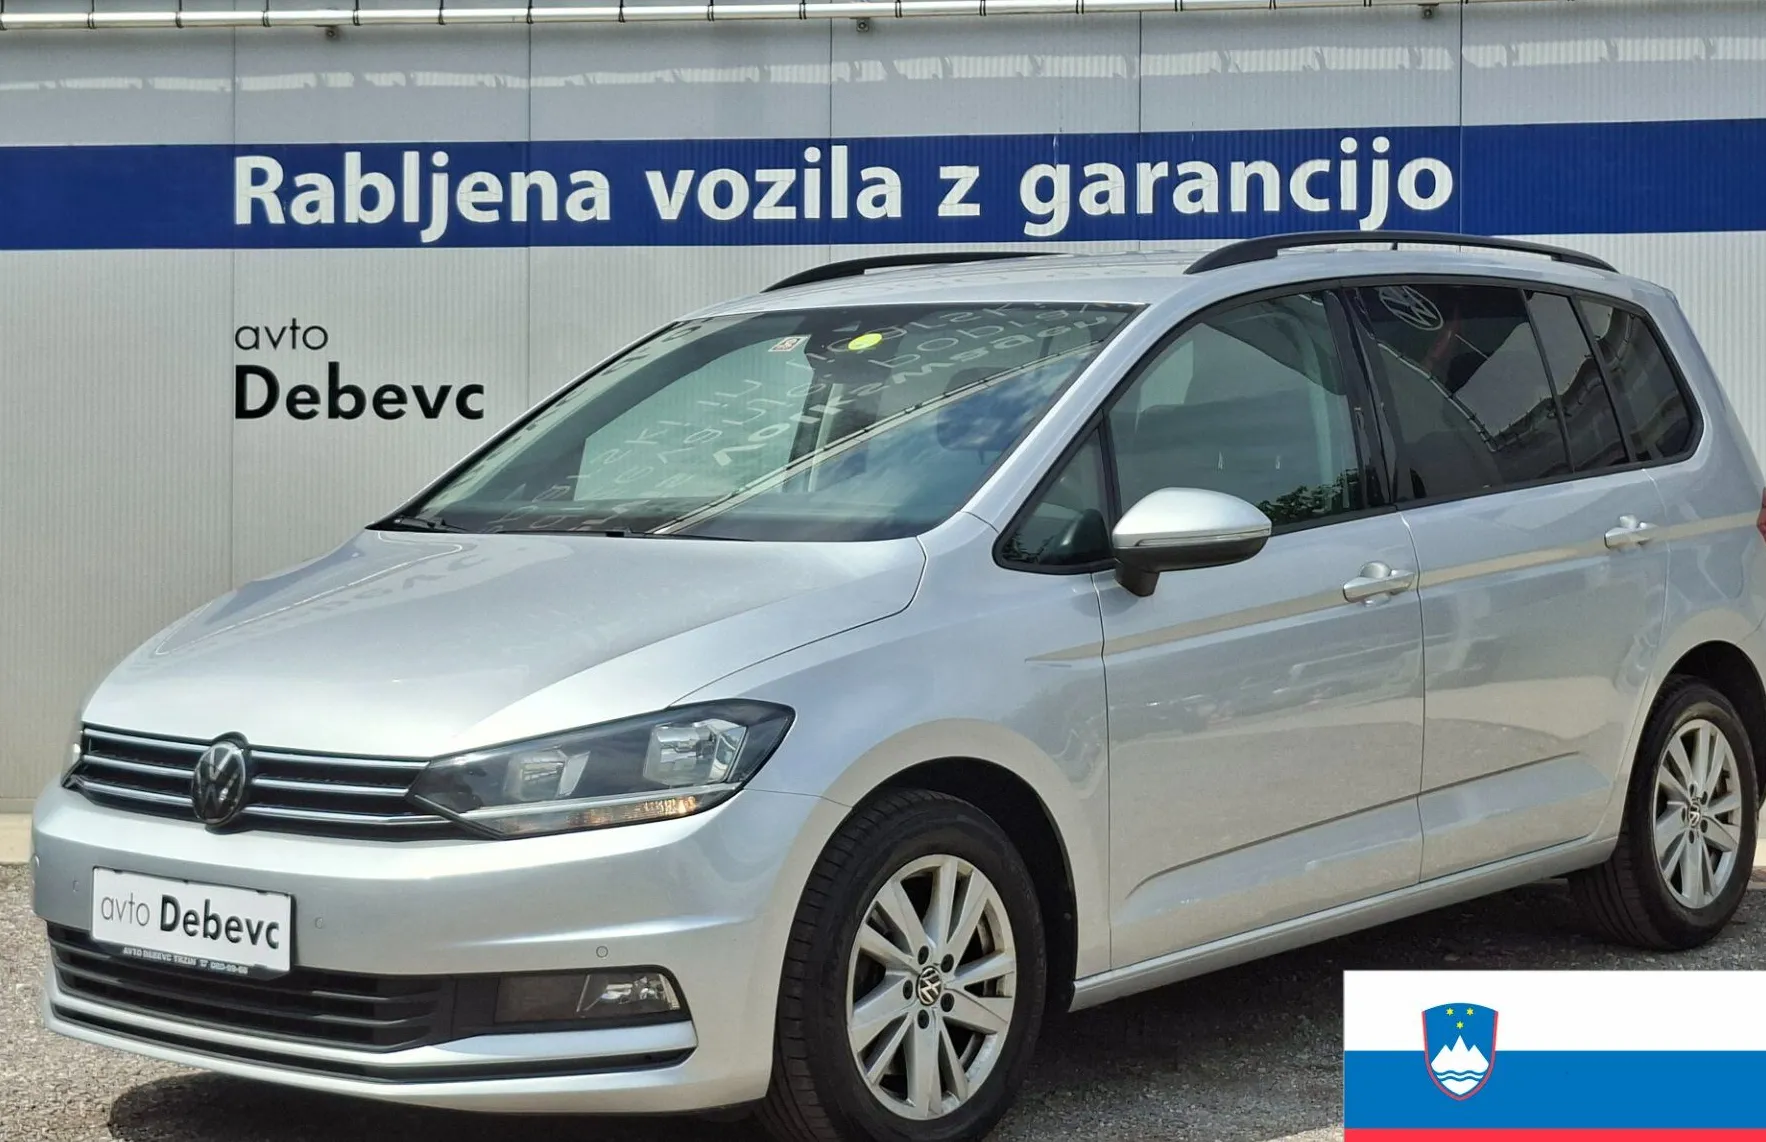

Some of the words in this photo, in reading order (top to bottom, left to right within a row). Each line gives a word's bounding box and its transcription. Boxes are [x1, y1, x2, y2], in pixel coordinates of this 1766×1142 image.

[235, 151, 610, 243] Rabljena
[645, 145, 902, 220] vozila
[938, 165, 981, 217] z
[1018, 136, 1453, 237] garancijo
[235, 317, 328, 352] avto
[235, 361, 485, 421] Debevc
[101, 892, 150, 926] avto
[160, 894, 280, 949] Debevc
